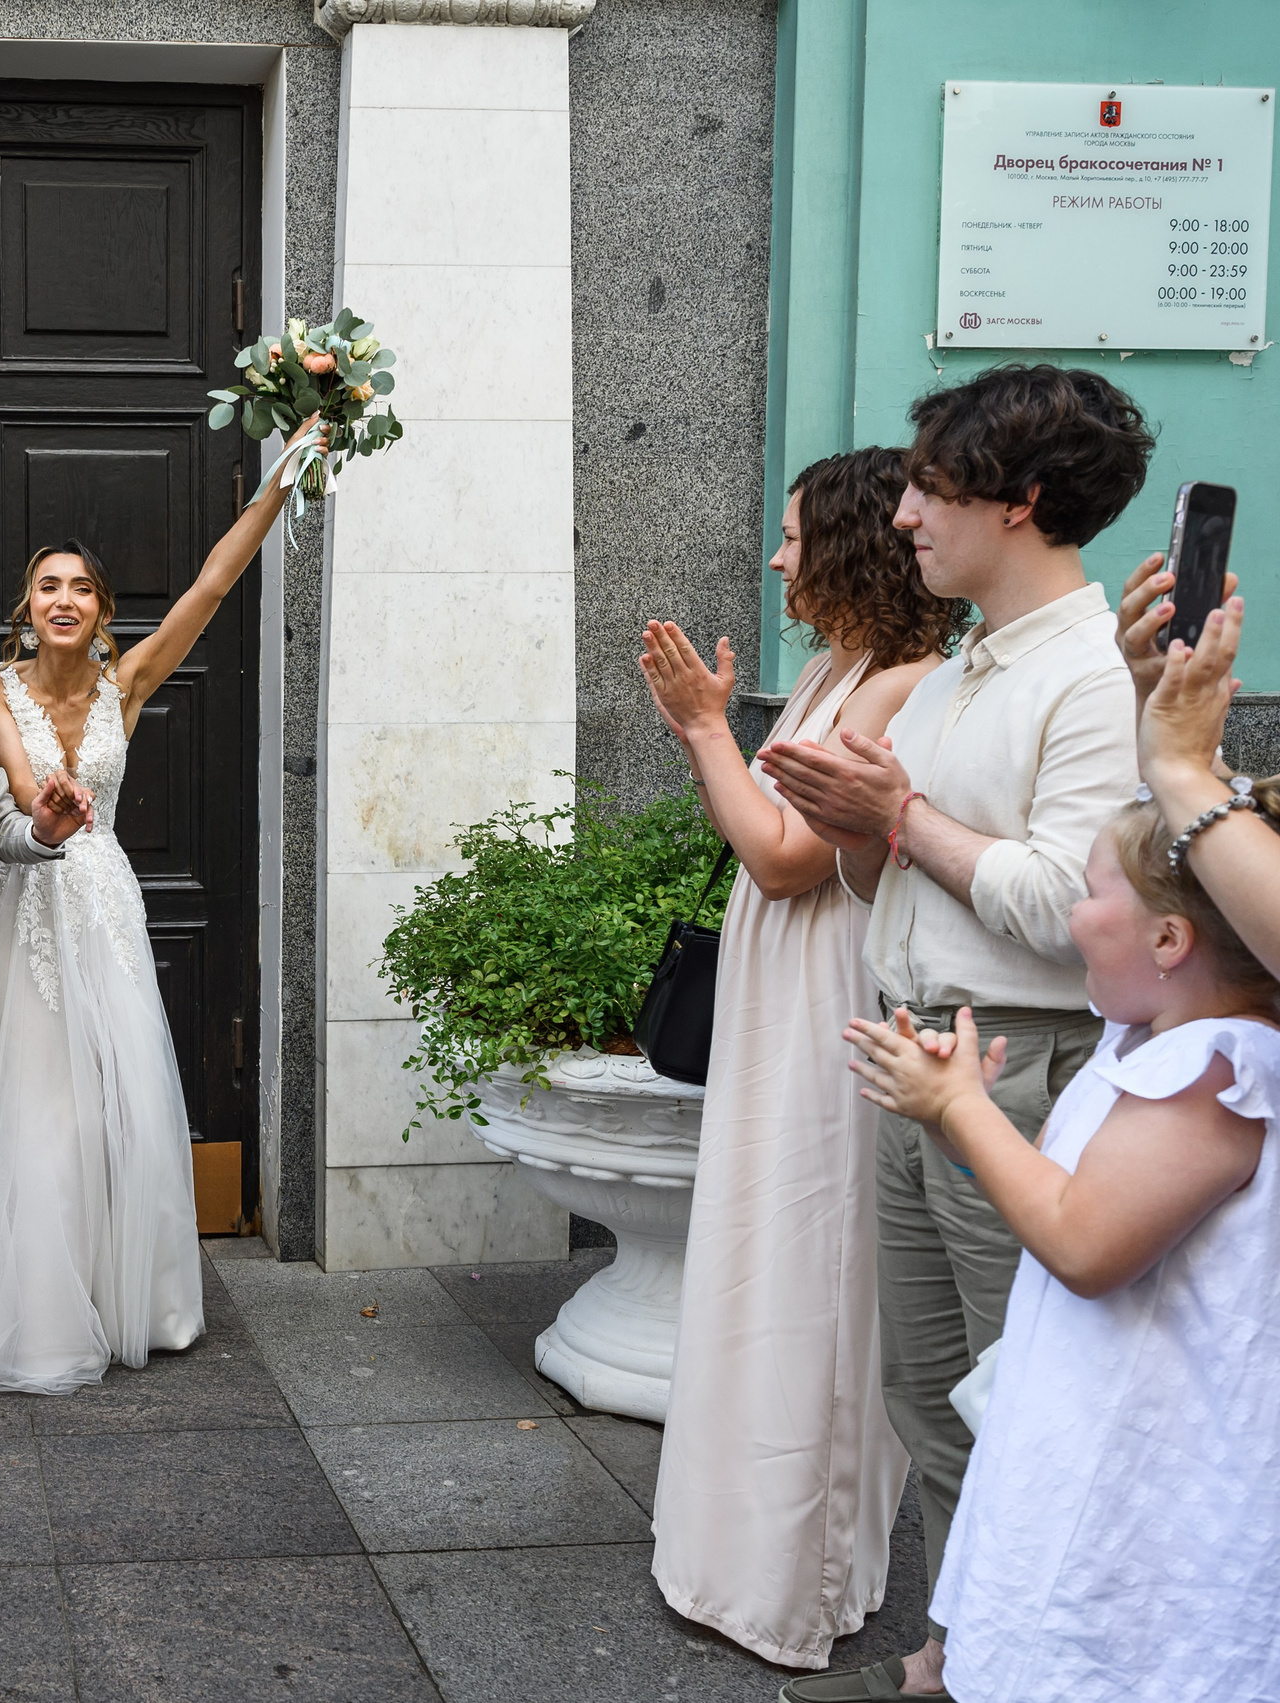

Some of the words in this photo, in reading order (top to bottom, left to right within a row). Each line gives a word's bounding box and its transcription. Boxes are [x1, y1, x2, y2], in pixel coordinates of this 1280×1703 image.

[1110, 132, 1157, 140] ГРАЖДАНСКОГО
[994, 154, 1055, 173] Дворец
[1059, 154, 1188, 174] бракосочетания
[1192, 158, 1212, 172] №
[1217, 158, 1223, 172] 1
[1052, 195, 1104, 209] РЕЖИМ
[1108, 196, 1162, 210] РАБОТЫ
[961, 221, 1012, 229] ПОНЕДЕЛЬНИК
[1169, 218, 1200, 232] 9:00
[1214, 219, 1249, 233] 18:00
[961, 244, 993, 252] ПЯТНИЦА
[1168, 241, 1199, 255] 9:00
[1210, 241, 1249, 255] 20:00
[960, 267, 991, 275] СУББОТА
[1167, 263, 1198, 277] 9:00
[1209, 264, 1248, 278] 23:59
[959, 290, 1006, 298] ВОСКРЕСЕНЬЕ
[1158, 286, 1197, 300] 00:00
[1210, 287, 1247, 301] 19:00
[986, 317, 1006, 325] ЗАГС
[1006, 317, 1043, 325] МОСКВЫ
